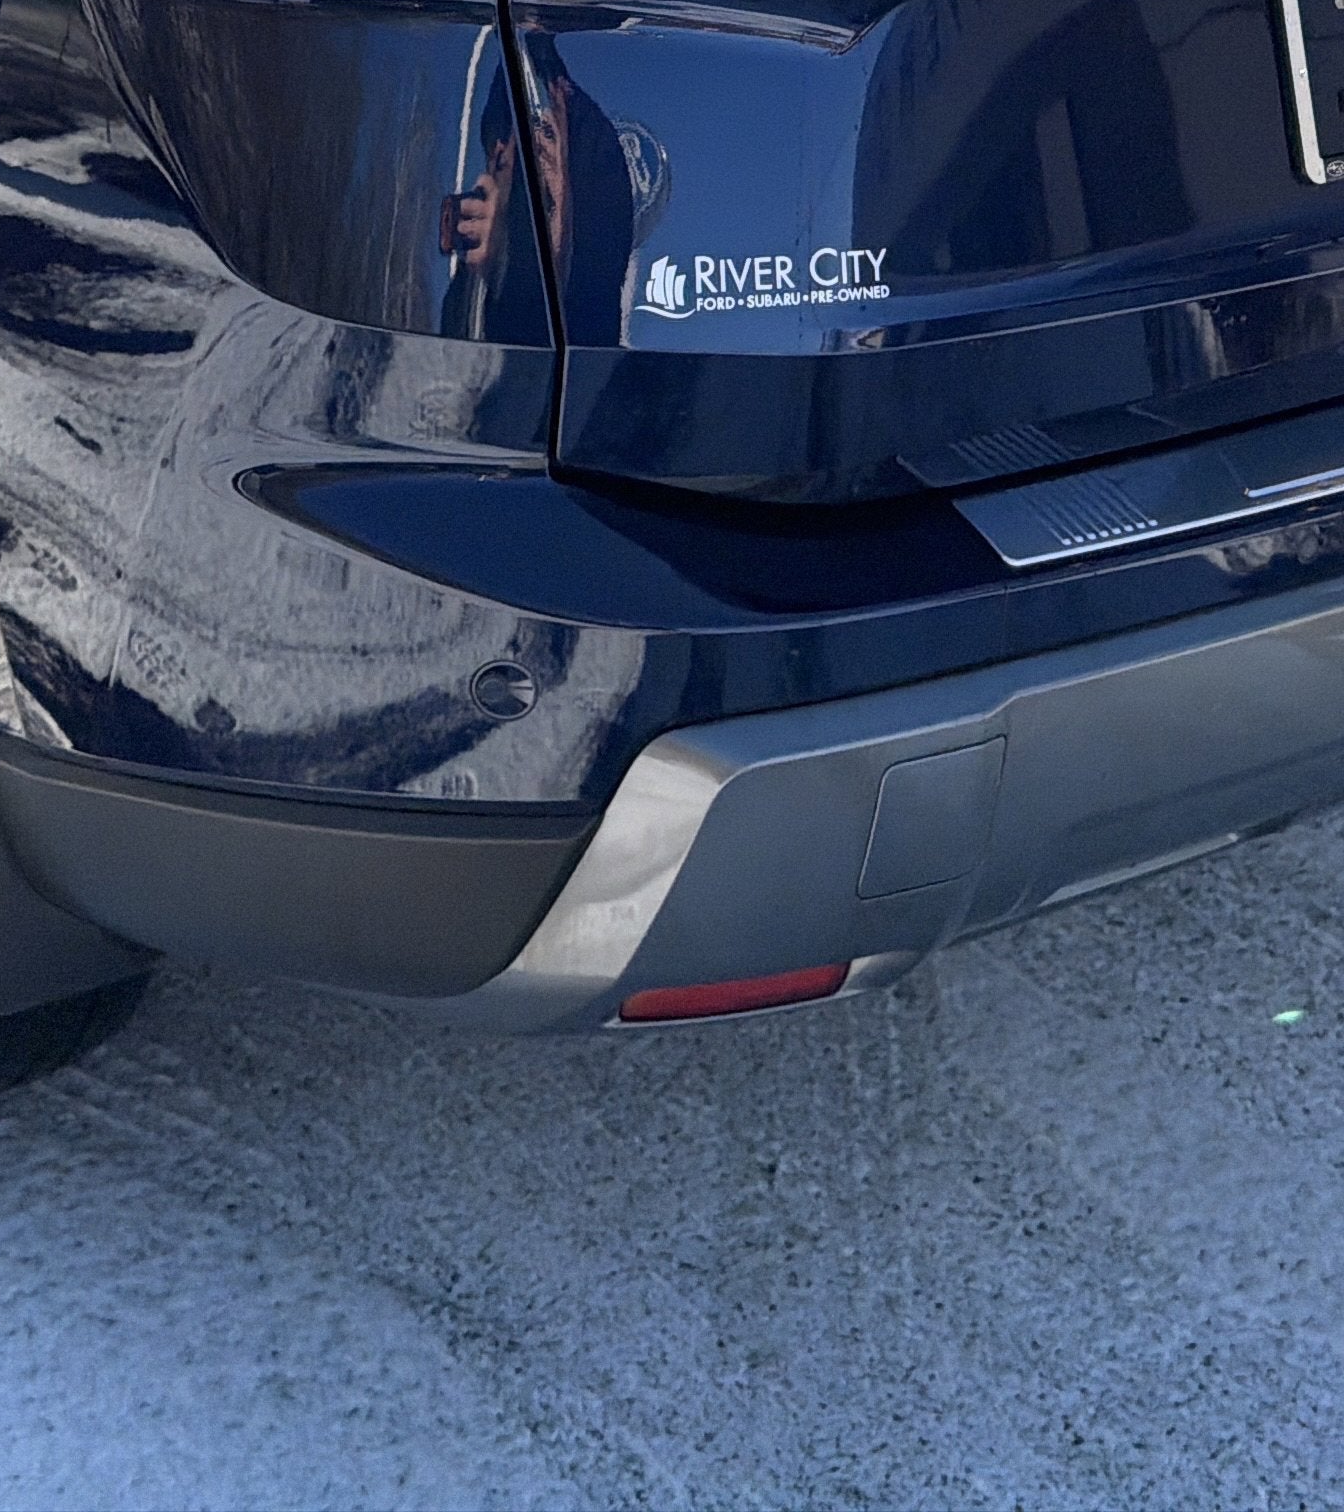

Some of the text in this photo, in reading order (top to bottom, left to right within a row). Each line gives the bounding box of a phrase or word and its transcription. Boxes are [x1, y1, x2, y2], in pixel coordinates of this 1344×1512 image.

[694, 247, 887, 295] RIVER CITY
[696, 284, 890, 311] FORD SUBARU PRE-OWNED
